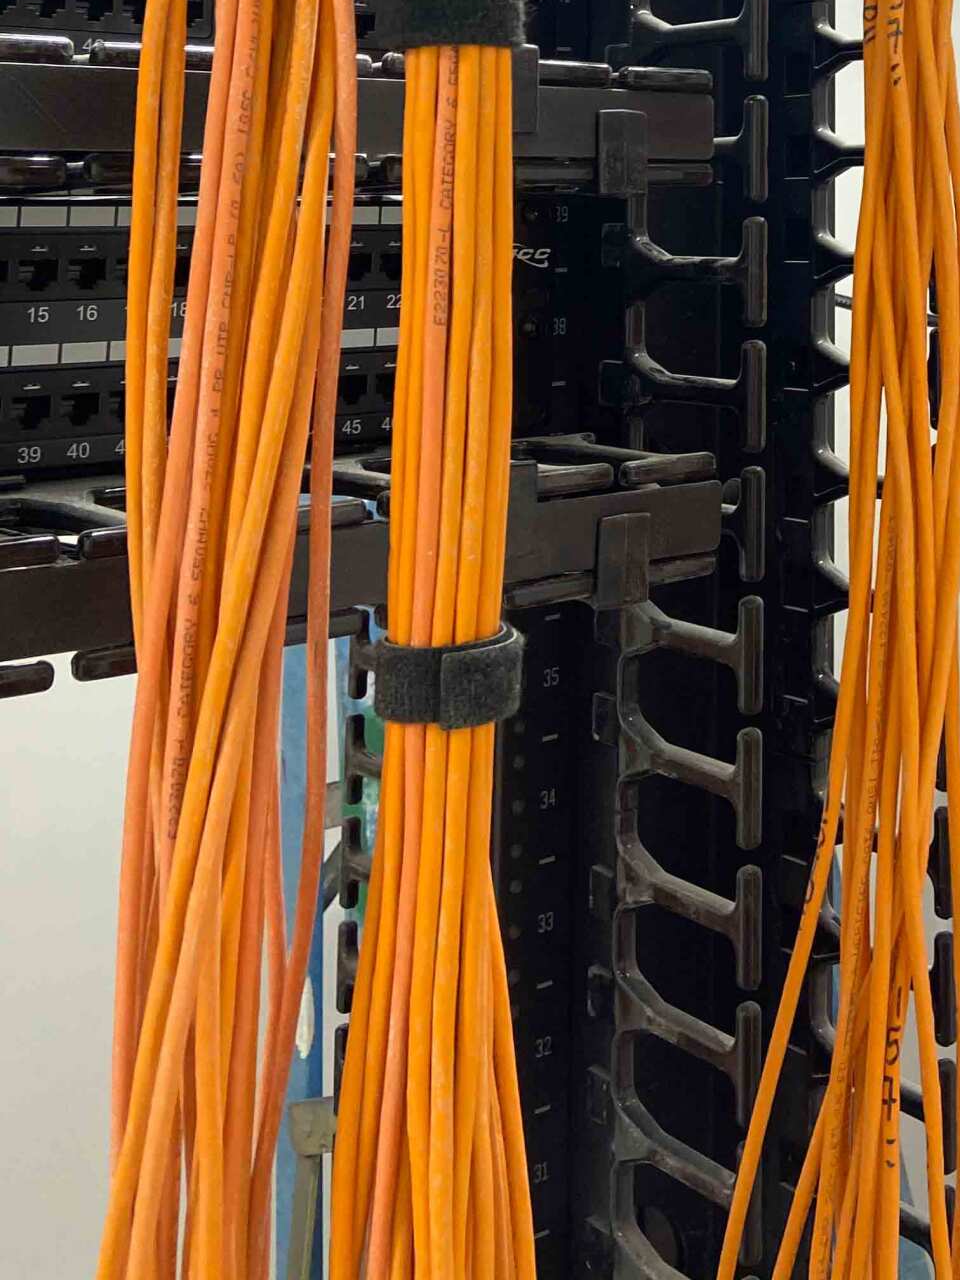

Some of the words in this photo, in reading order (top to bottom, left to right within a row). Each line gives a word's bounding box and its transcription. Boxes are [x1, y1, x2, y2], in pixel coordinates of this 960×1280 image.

[554, 205, 569, 223] 39
[26, 306, 49, 323] 15
[76, 304, 98, 321] 16
[170, 302, 187, 318] 18
[348, 295, 365, 310] 21
[386, 294, 402, 310] 22
[553, 317, 566, 336] 38
[17, 446, 41, 464] 39
[67, 442, 90, 459] 40
[115, 440, 126, 454] 4
[342, 419, 361, 435] 45
[381, 416, 392, 431] 4
[543, 666, 560, 688] 35
[540, 788, 556, 810] 34
[537, 911, 554, 933] 33
[535, 1036, 552, 1058] 32
[534, 1161, 550, 1184] 31
